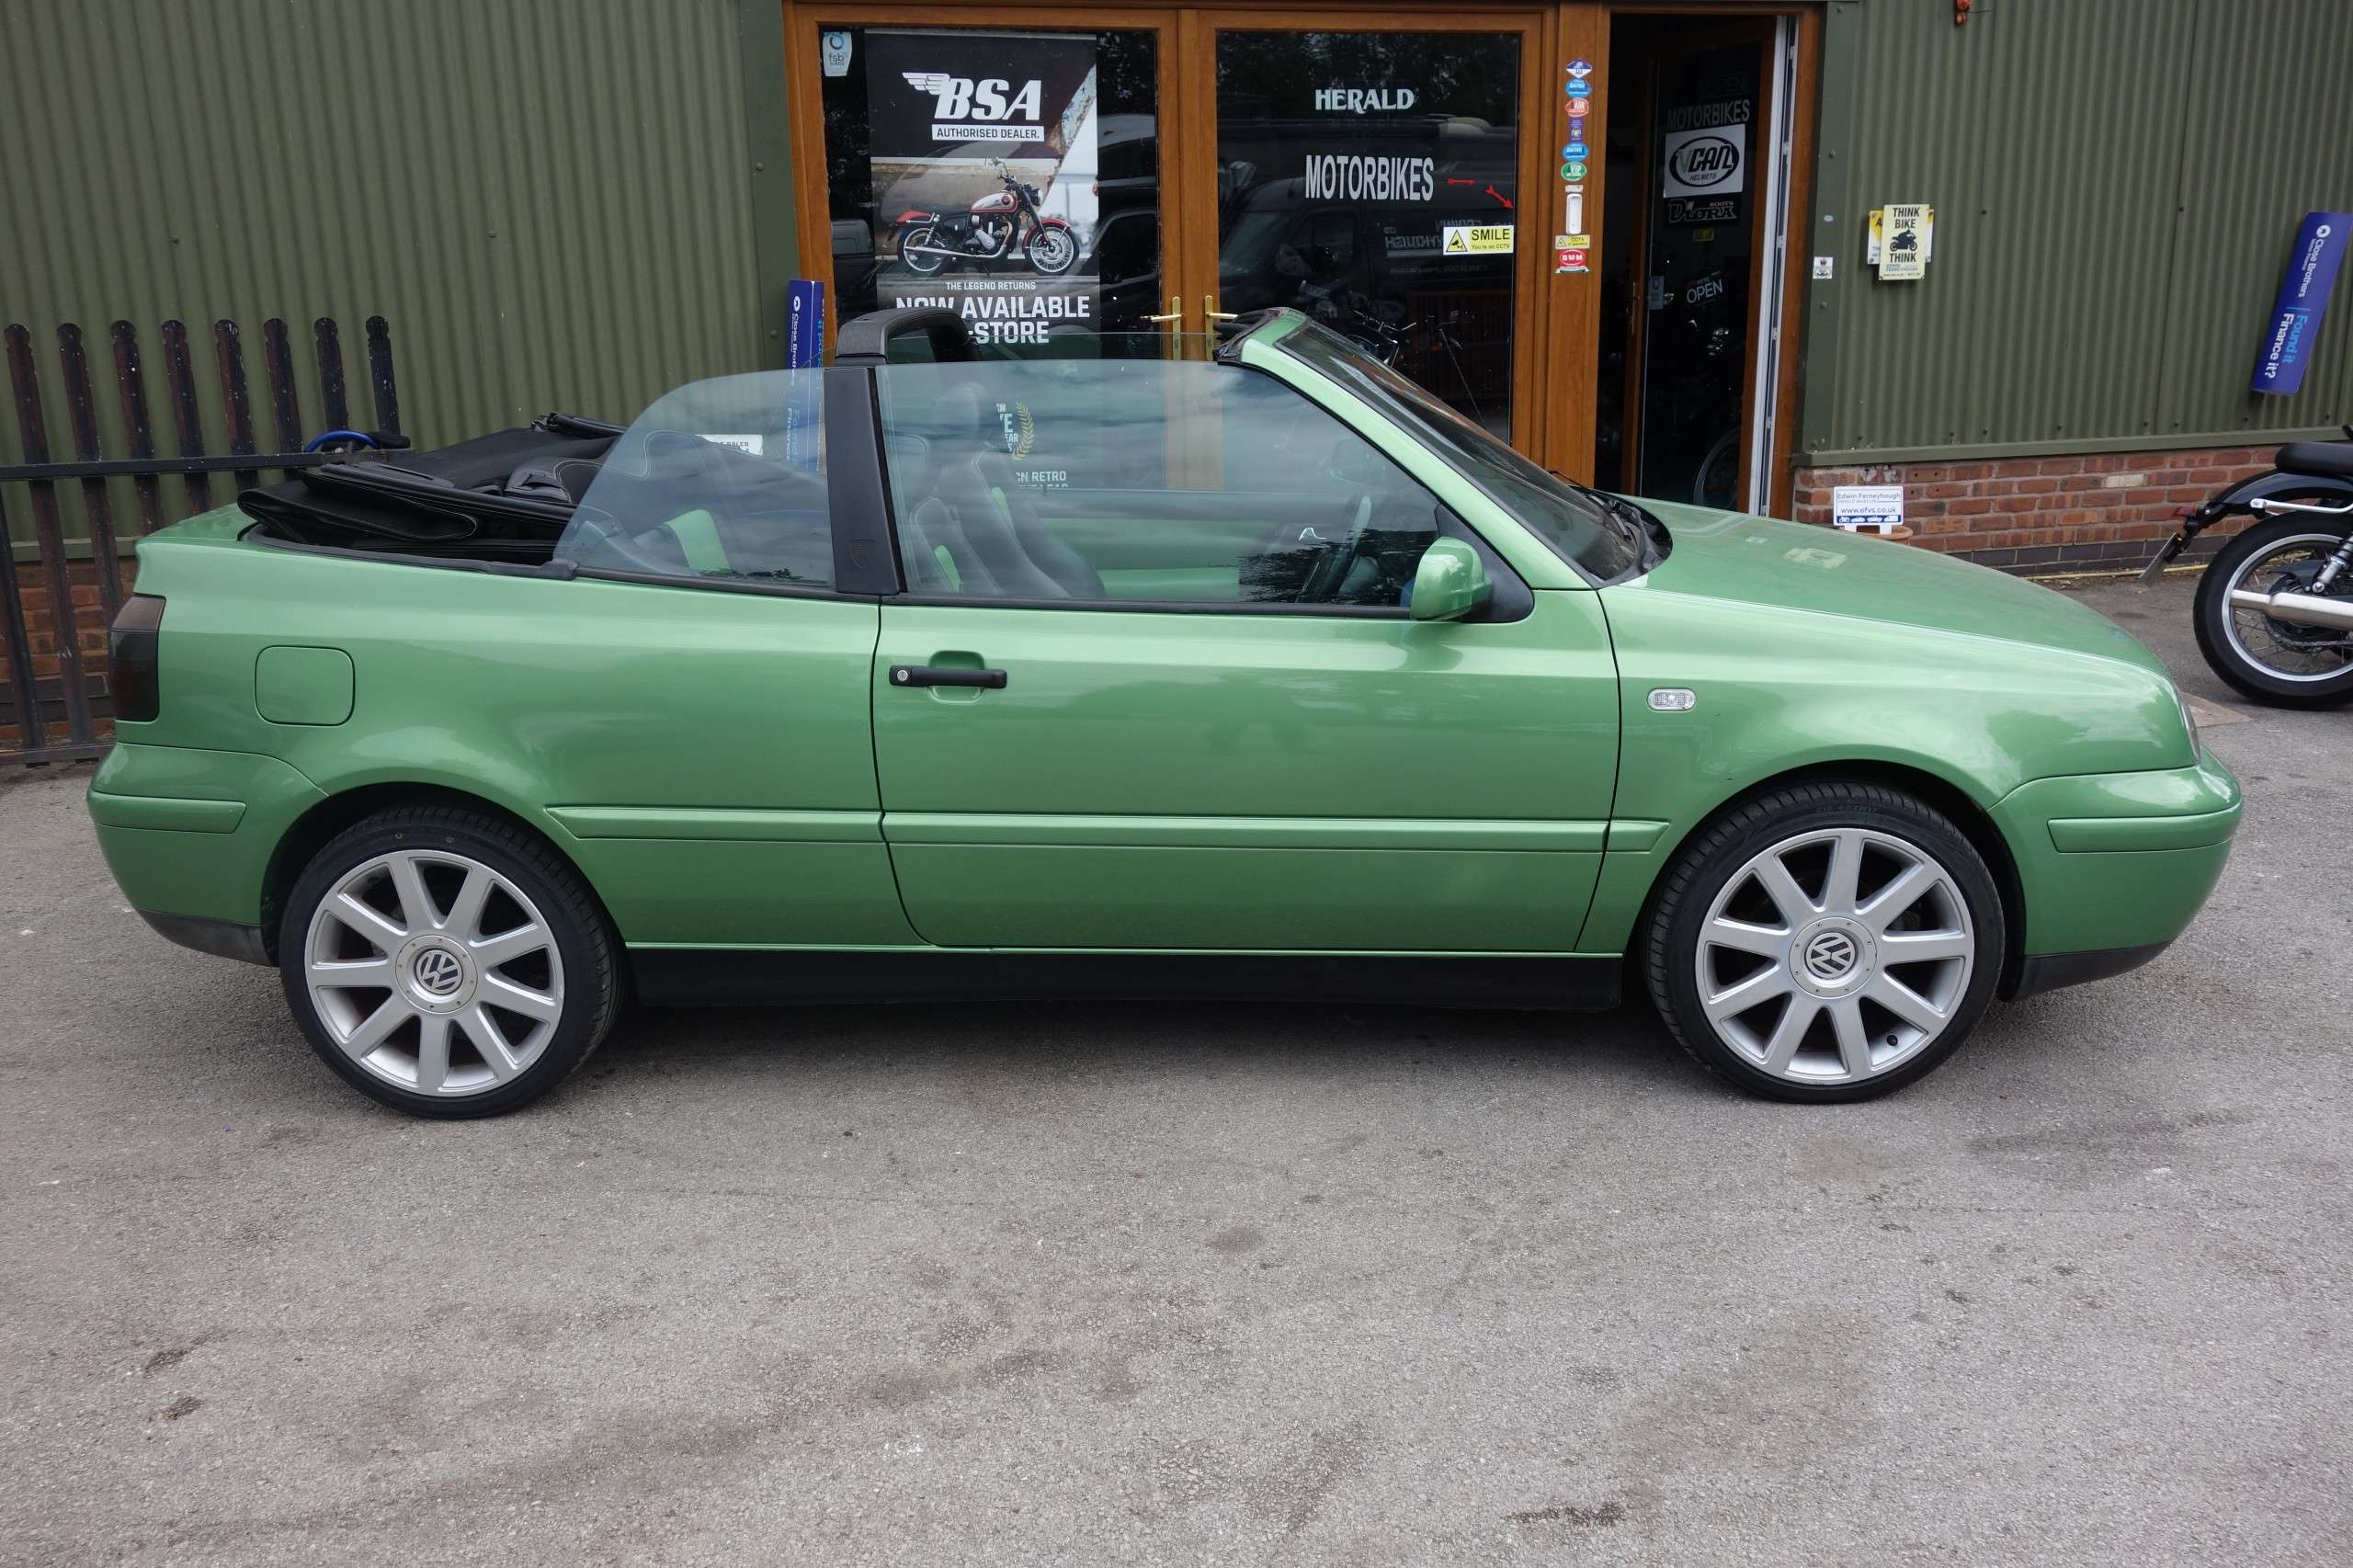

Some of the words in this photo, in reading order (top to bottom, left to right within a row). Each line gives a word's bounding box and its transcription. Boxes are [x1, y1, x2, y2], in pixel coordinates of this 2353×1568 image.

[934, 78, 1041, 120] BSA
[1315, 89, 1415, 114] HERALD
[1668, 99, 1750, 130] MOTORBIKES
[937, 128, 998, 139] AUTHORISED
[1305, 154, 1434, 201] MOTORBIKES
[1893, 207, 1920, 218] THINK
[1894, 219, 1916, 229] BIKE
[1472, 228, 1510, 242] SMILE
[1890, 253, 1917, 263] THINK
[2308, 239, 2325, 262] Close
[946, 281, 961, 290] THE
[963, 281, 995, 290] LEGEND
[997, 281, 1037, 290] RETURNS
[1687, 278, 1723, 303] OPEN
[2299, 262, 2317, 298] Brothers
[961, 296, 1090, 319] AVAILABLE
[2270, 312, 2295, 360] Finance
[2285, 314, 2309, 354] Found
[2265, 361, 2280, 380] it?
[2282, 355, 2295, 364] it
[1031, 471, 1066, 483] RETRO
